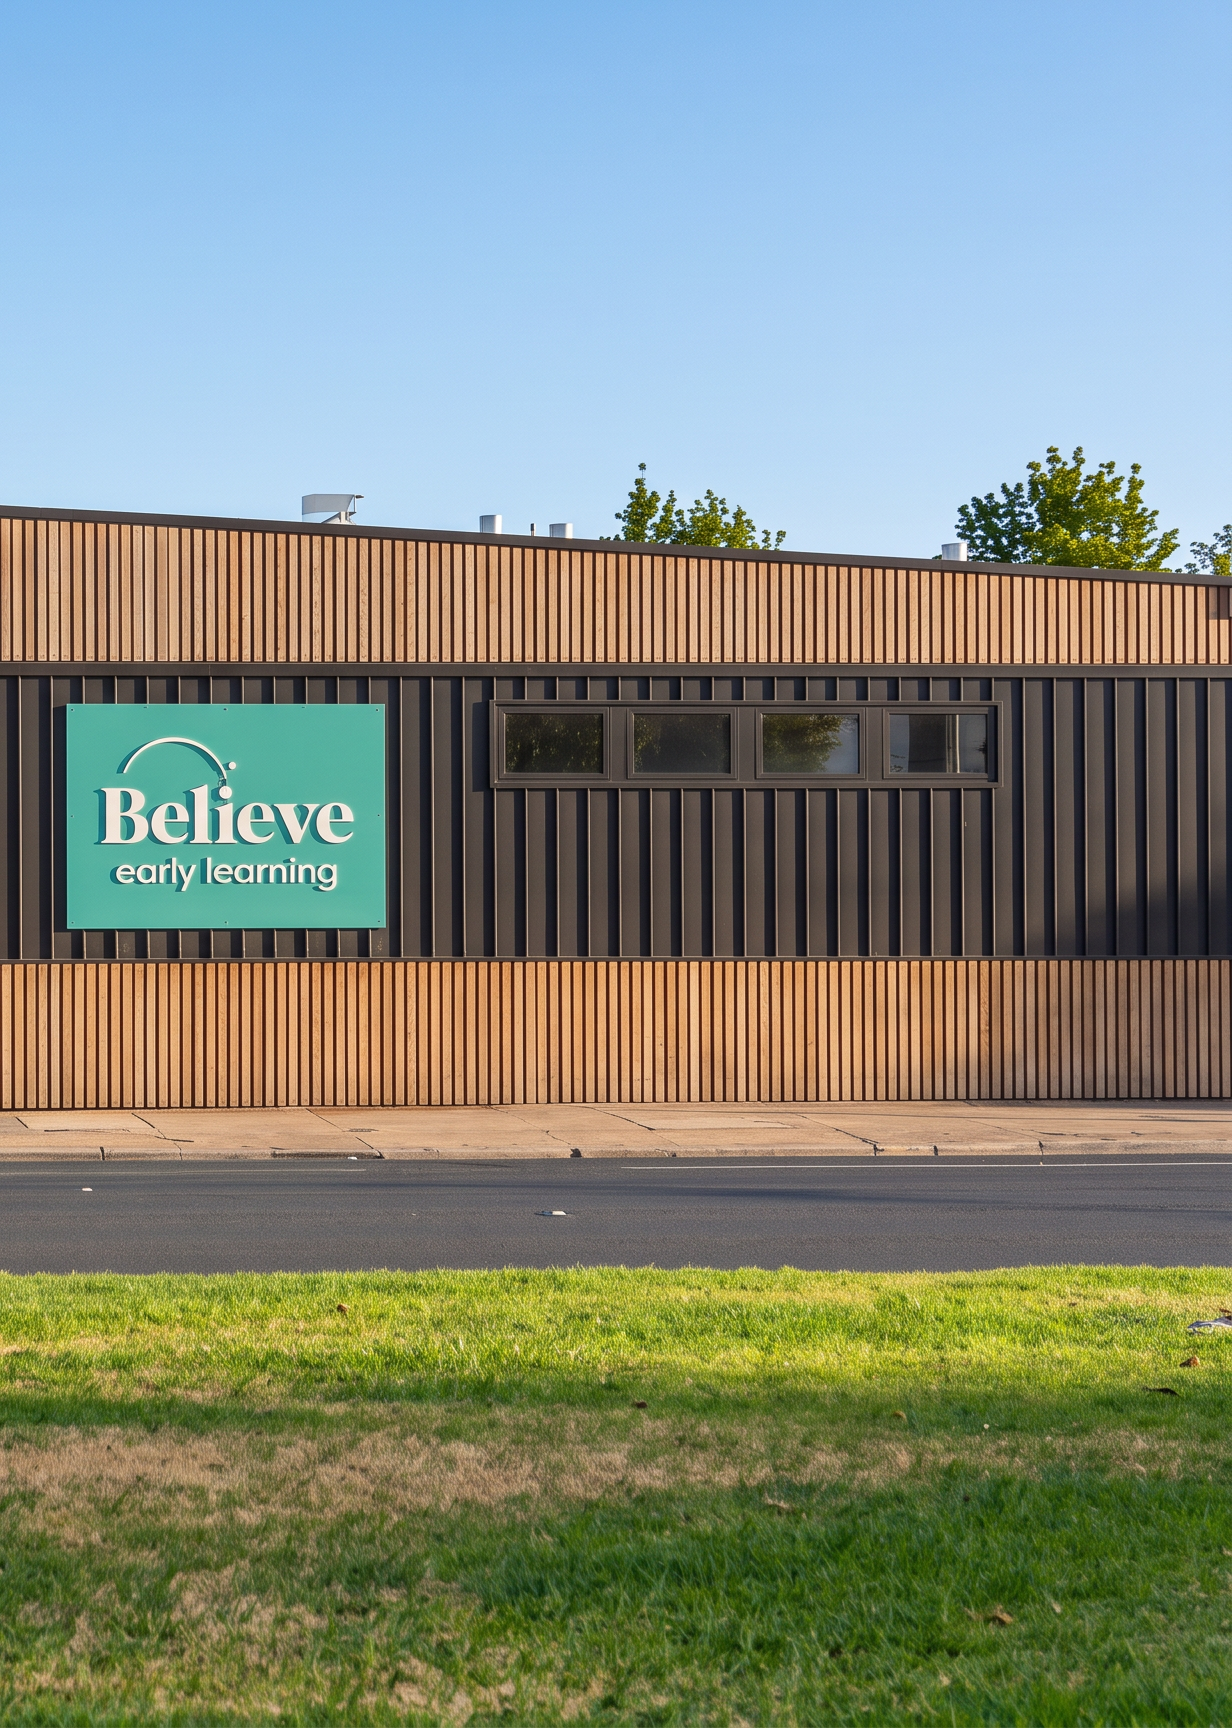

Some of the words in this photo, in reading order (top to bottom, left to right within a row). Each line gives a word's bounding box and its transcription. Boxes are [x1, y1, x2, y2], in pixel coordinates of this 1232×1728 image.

[100, 783, 355, 845] Believe
[115, 857, 197, 892] early
[206, 856, 338, 892] learning
